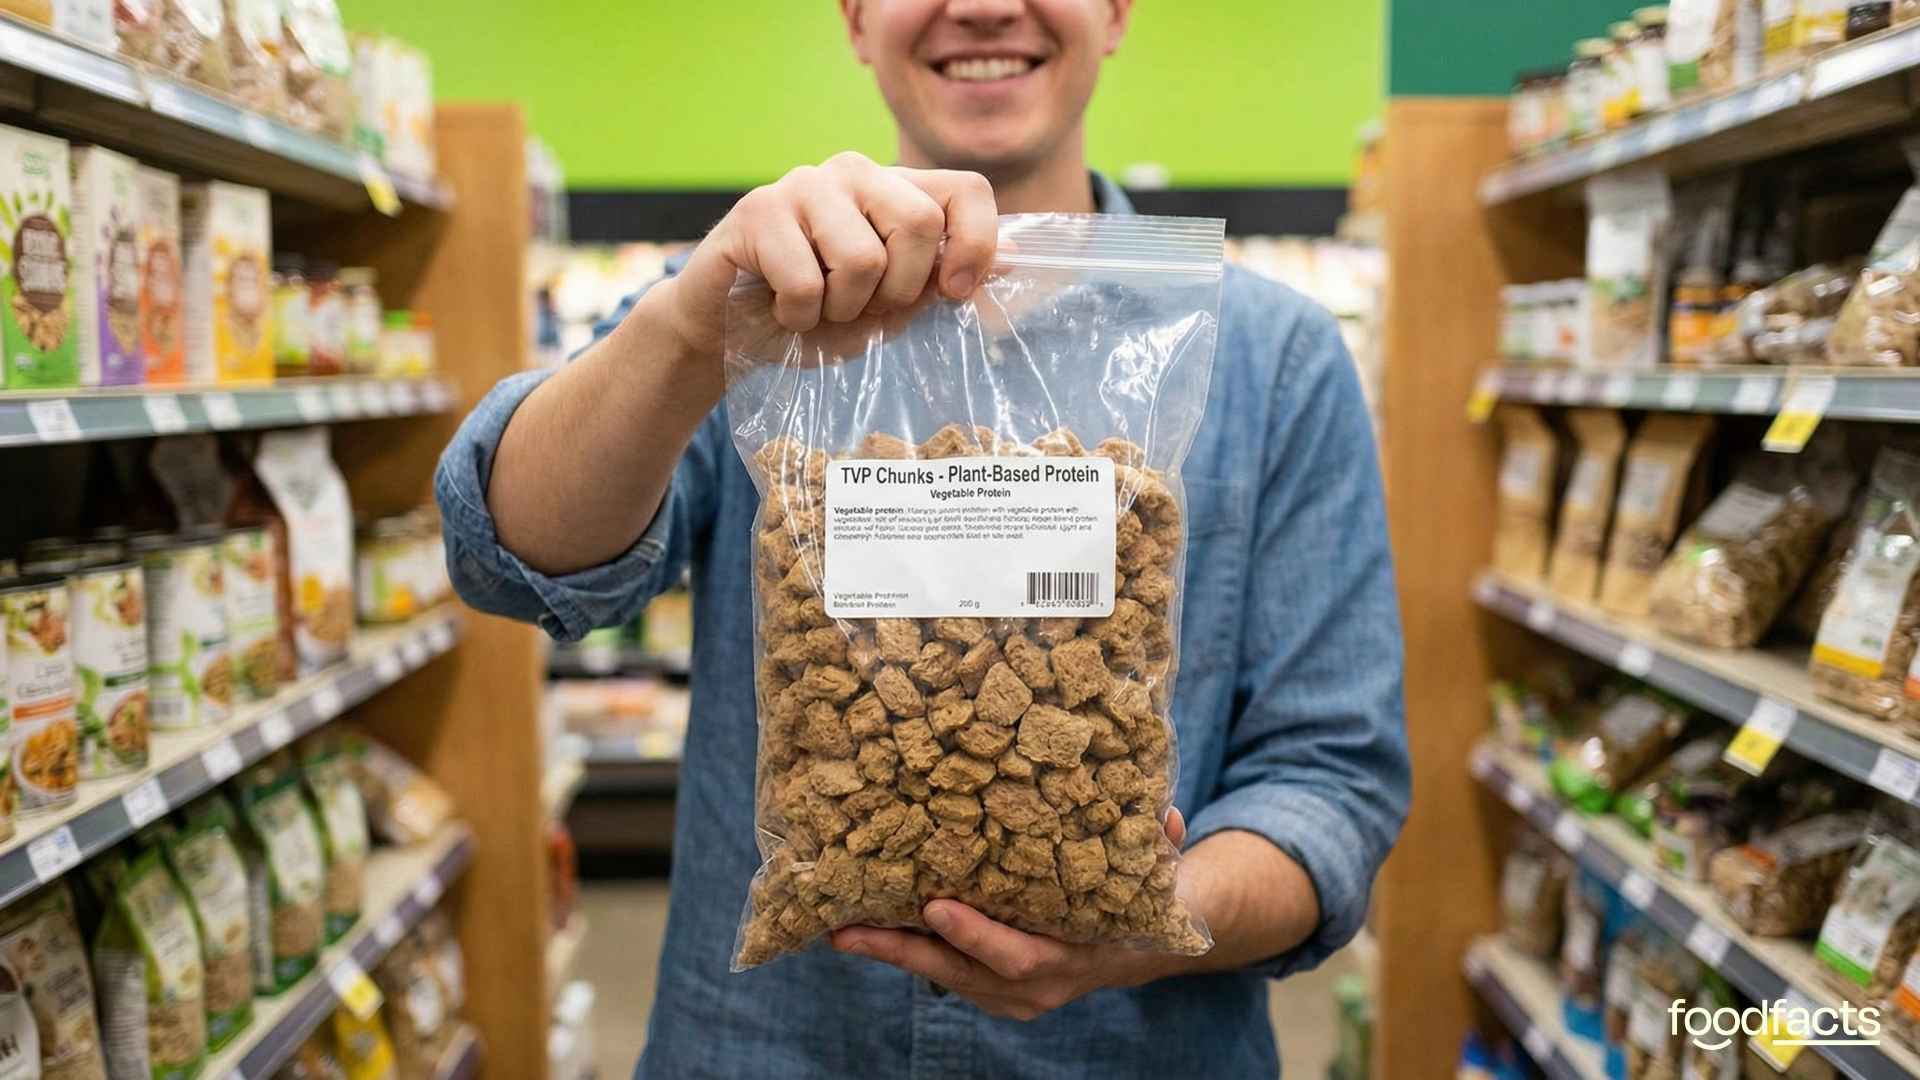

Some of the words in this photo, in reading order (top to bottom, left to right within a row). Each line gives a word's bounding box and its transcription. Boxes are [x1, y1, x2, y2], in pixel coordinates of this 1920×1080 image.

[841, 467, 871, 484] TVP
[876, 467, 934, 484] Chunks
[949, 464, 1040, 483] Plant-Based
[1045, 464, 1099, 483] Protein
[930, 489, 974, 500] Vegetable
[977, 488, 1011, 498] Protein
[834, 507, 873, 516] Vegetable
